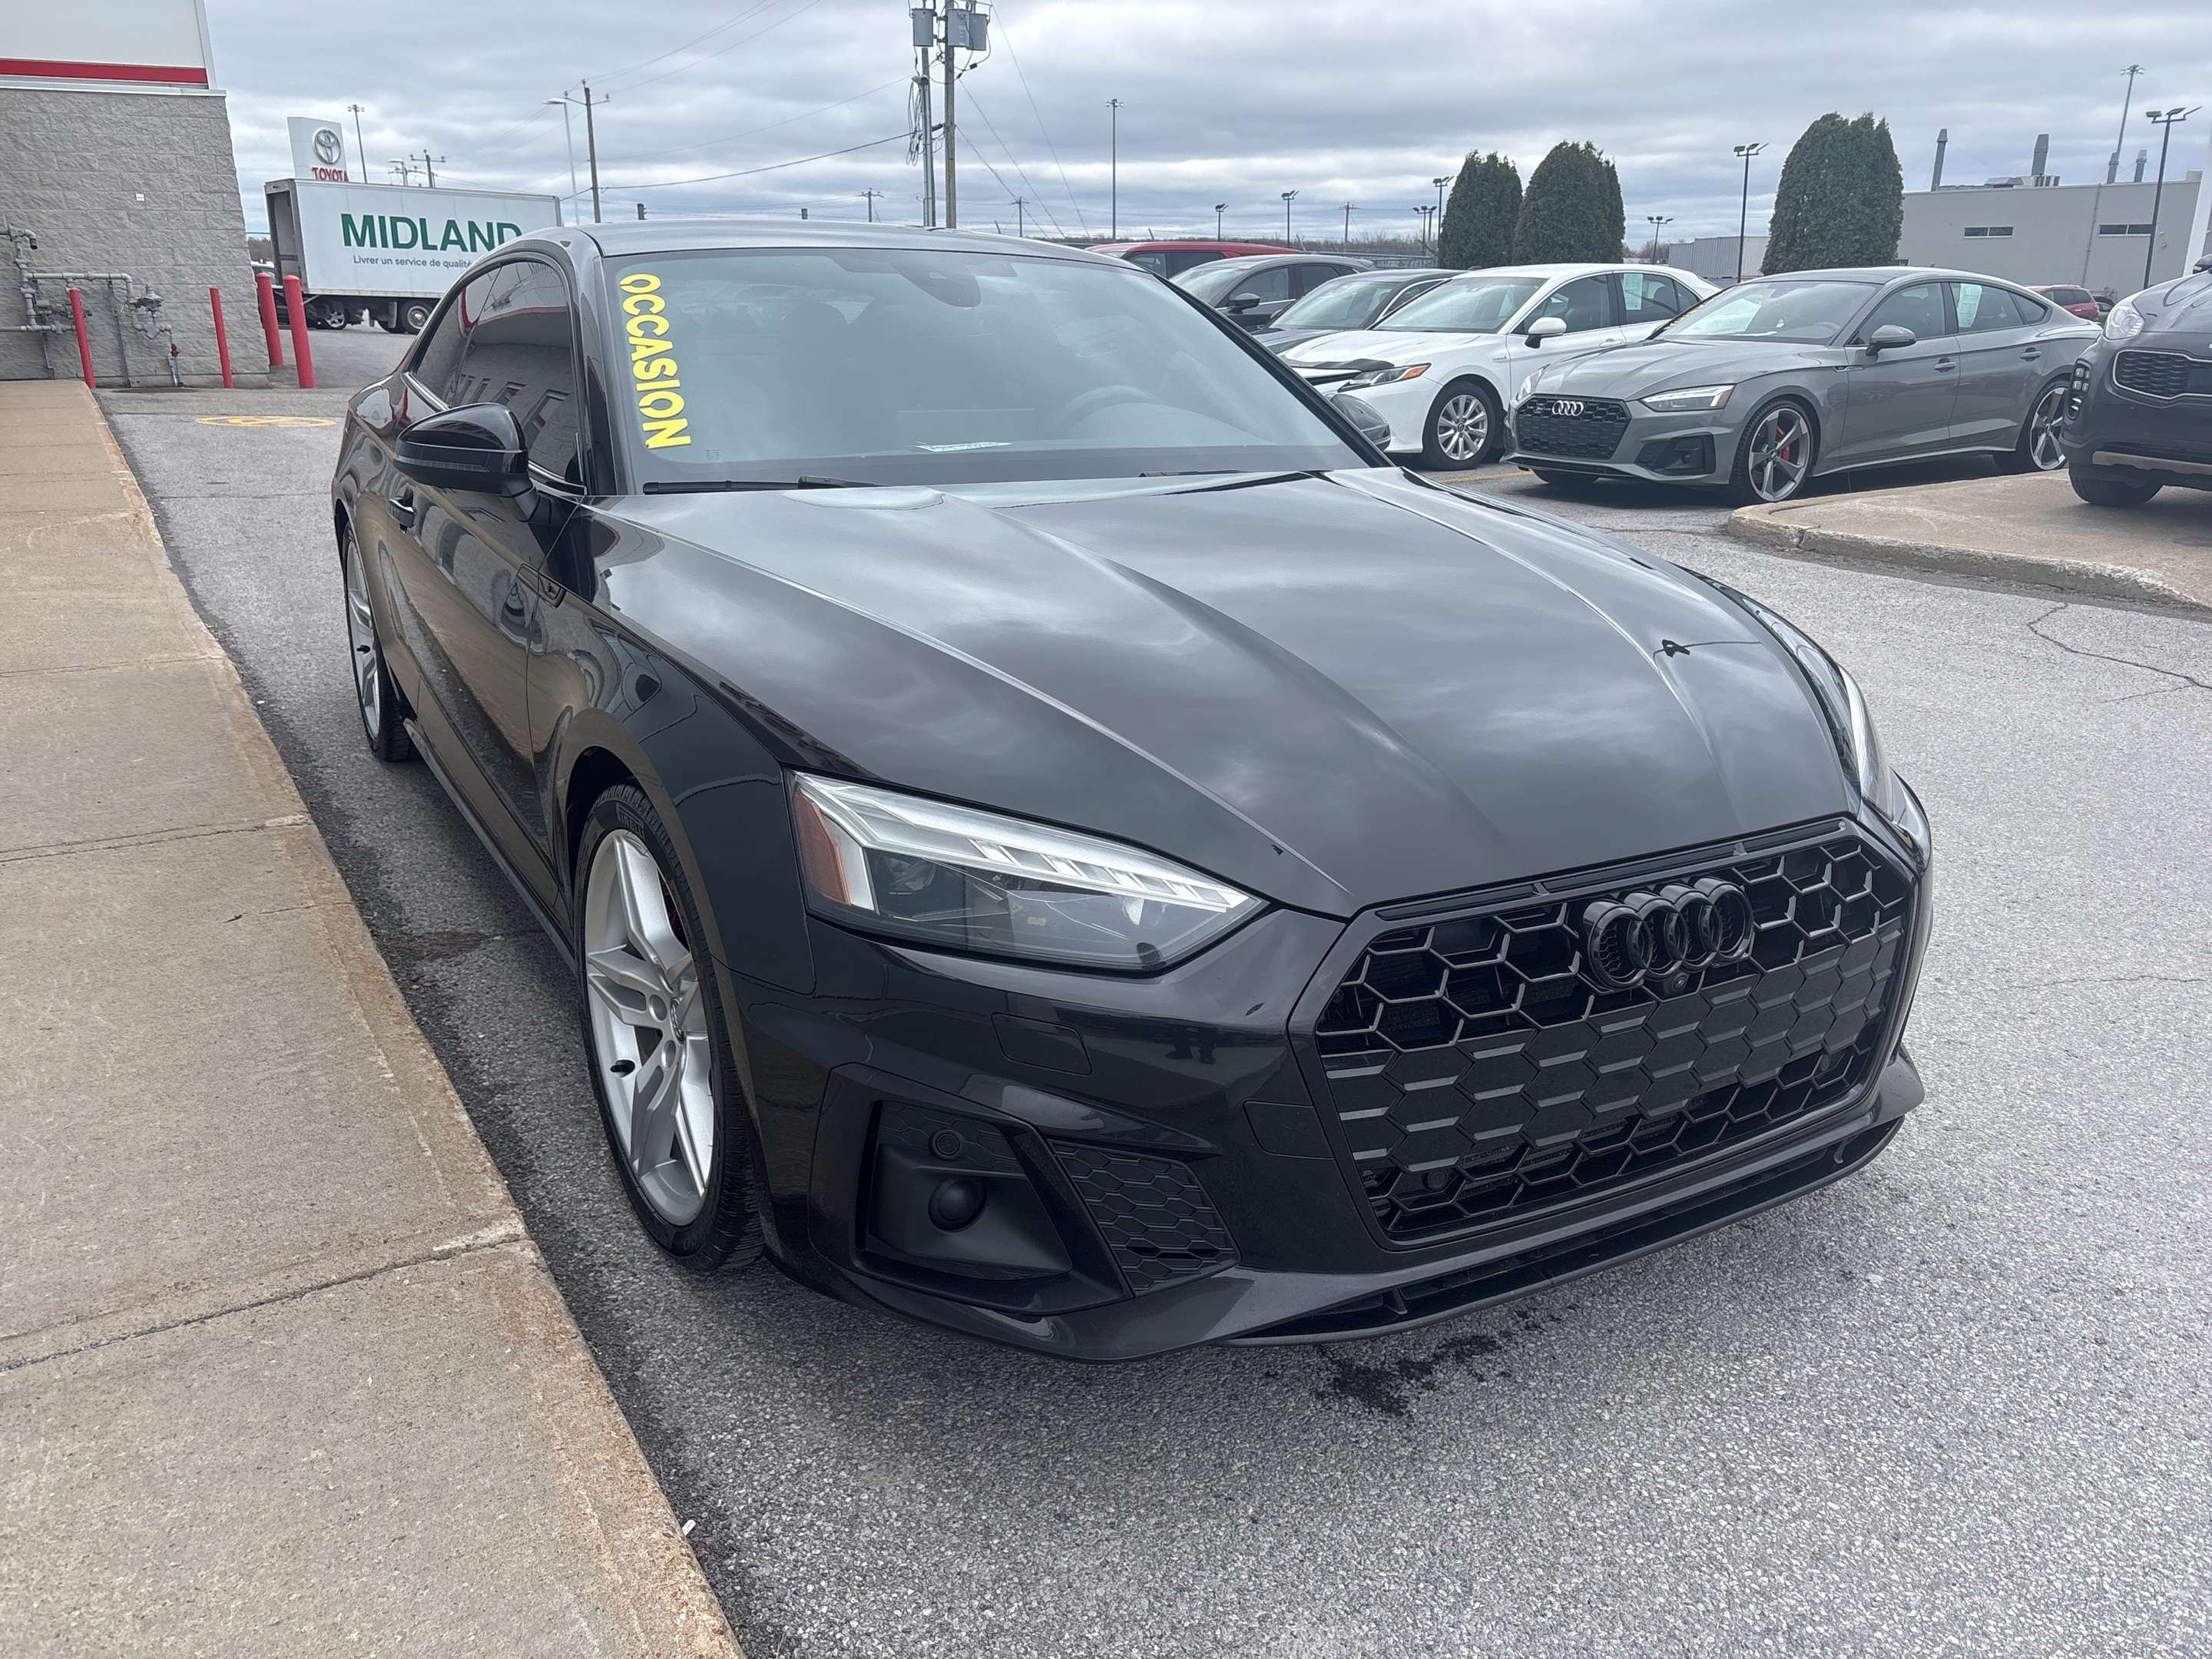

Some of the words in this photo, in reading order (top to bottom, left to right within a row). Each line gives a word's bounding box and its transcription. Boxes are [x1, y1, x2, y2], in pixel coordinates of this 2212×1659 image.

[312, 167, 349, 182] TOYOTA
[341, 214, 522, 253] MIDLAND
[353, 255, 379, 264] Livrer
[395, 257, 427, 267] service
[429, 259, 441, 267] de
[619, 273, 692, 449] OCCASION
